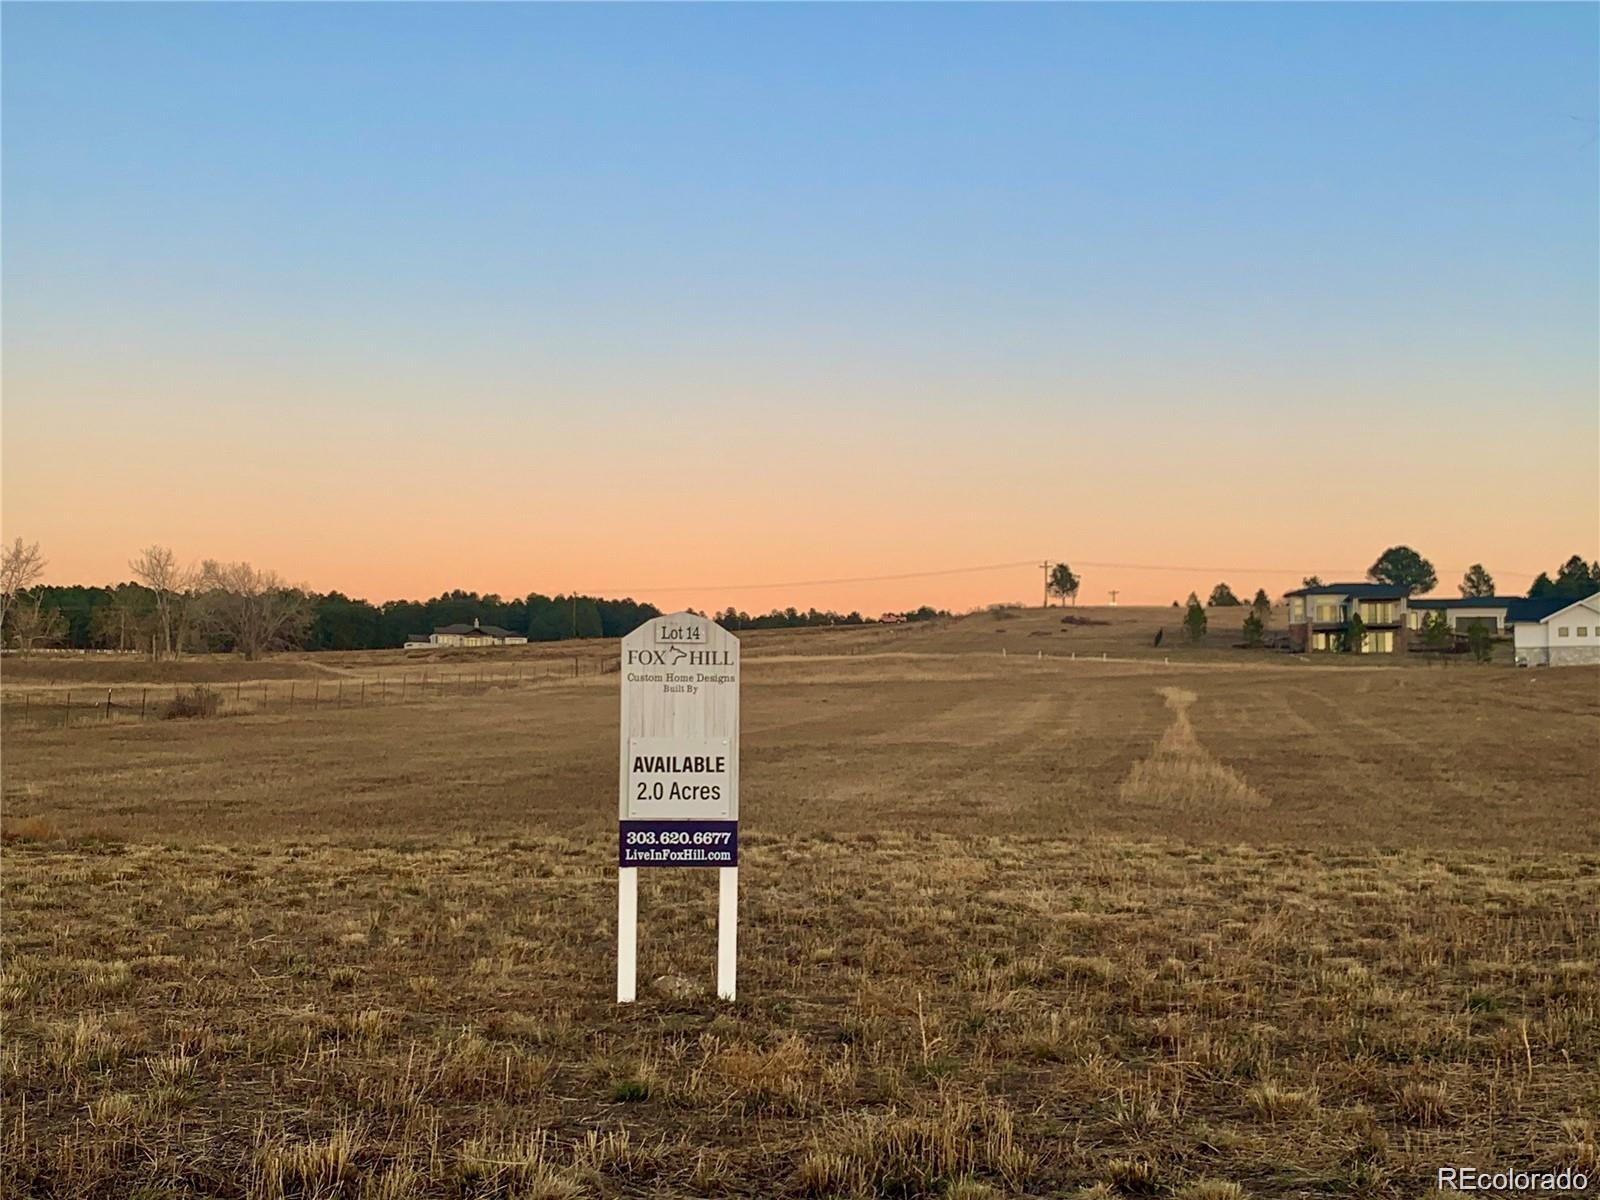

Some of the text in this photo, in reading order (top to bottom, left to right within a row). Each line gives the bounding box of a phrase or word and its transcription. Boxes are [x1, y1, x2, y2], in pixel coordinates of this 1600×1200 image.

[661, 626, 700, 640] Lot 14
[628, 650, 734, 665] FOX HILL
[627, 672, 735, 684] Custom Home Designs
[664, 685, 698, 694] Built By
[633, 756, 724, 772] AVAILABLE
[636, 782, 720, 800] 2.0 Acres
[626, 832, 732, 844] 303.620.6677
[625, 849, 731, 860] LiveInFoxHill.com
